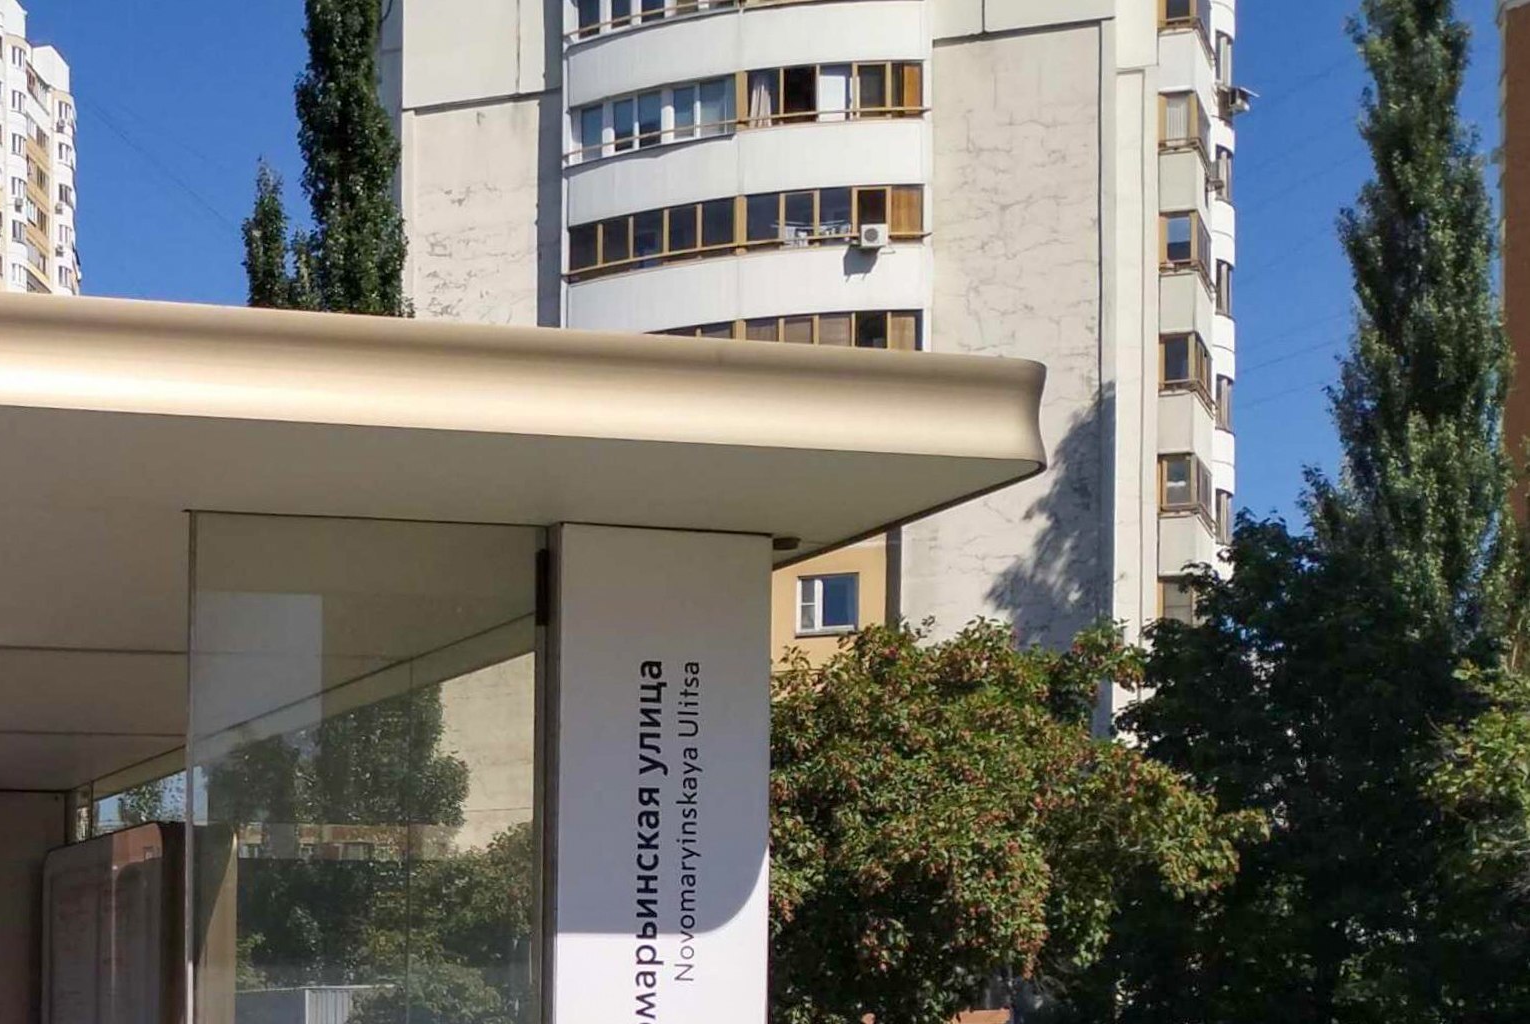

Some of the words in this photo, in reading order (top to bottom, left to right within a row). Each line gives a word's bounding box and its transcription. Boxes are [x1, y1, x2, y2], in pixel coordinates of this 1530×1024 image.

[637, 659, 669, 775] улица
[676, 660, 701, 737] Ulitsa
[674, 746, 703, 982] Novomaryinskaya
